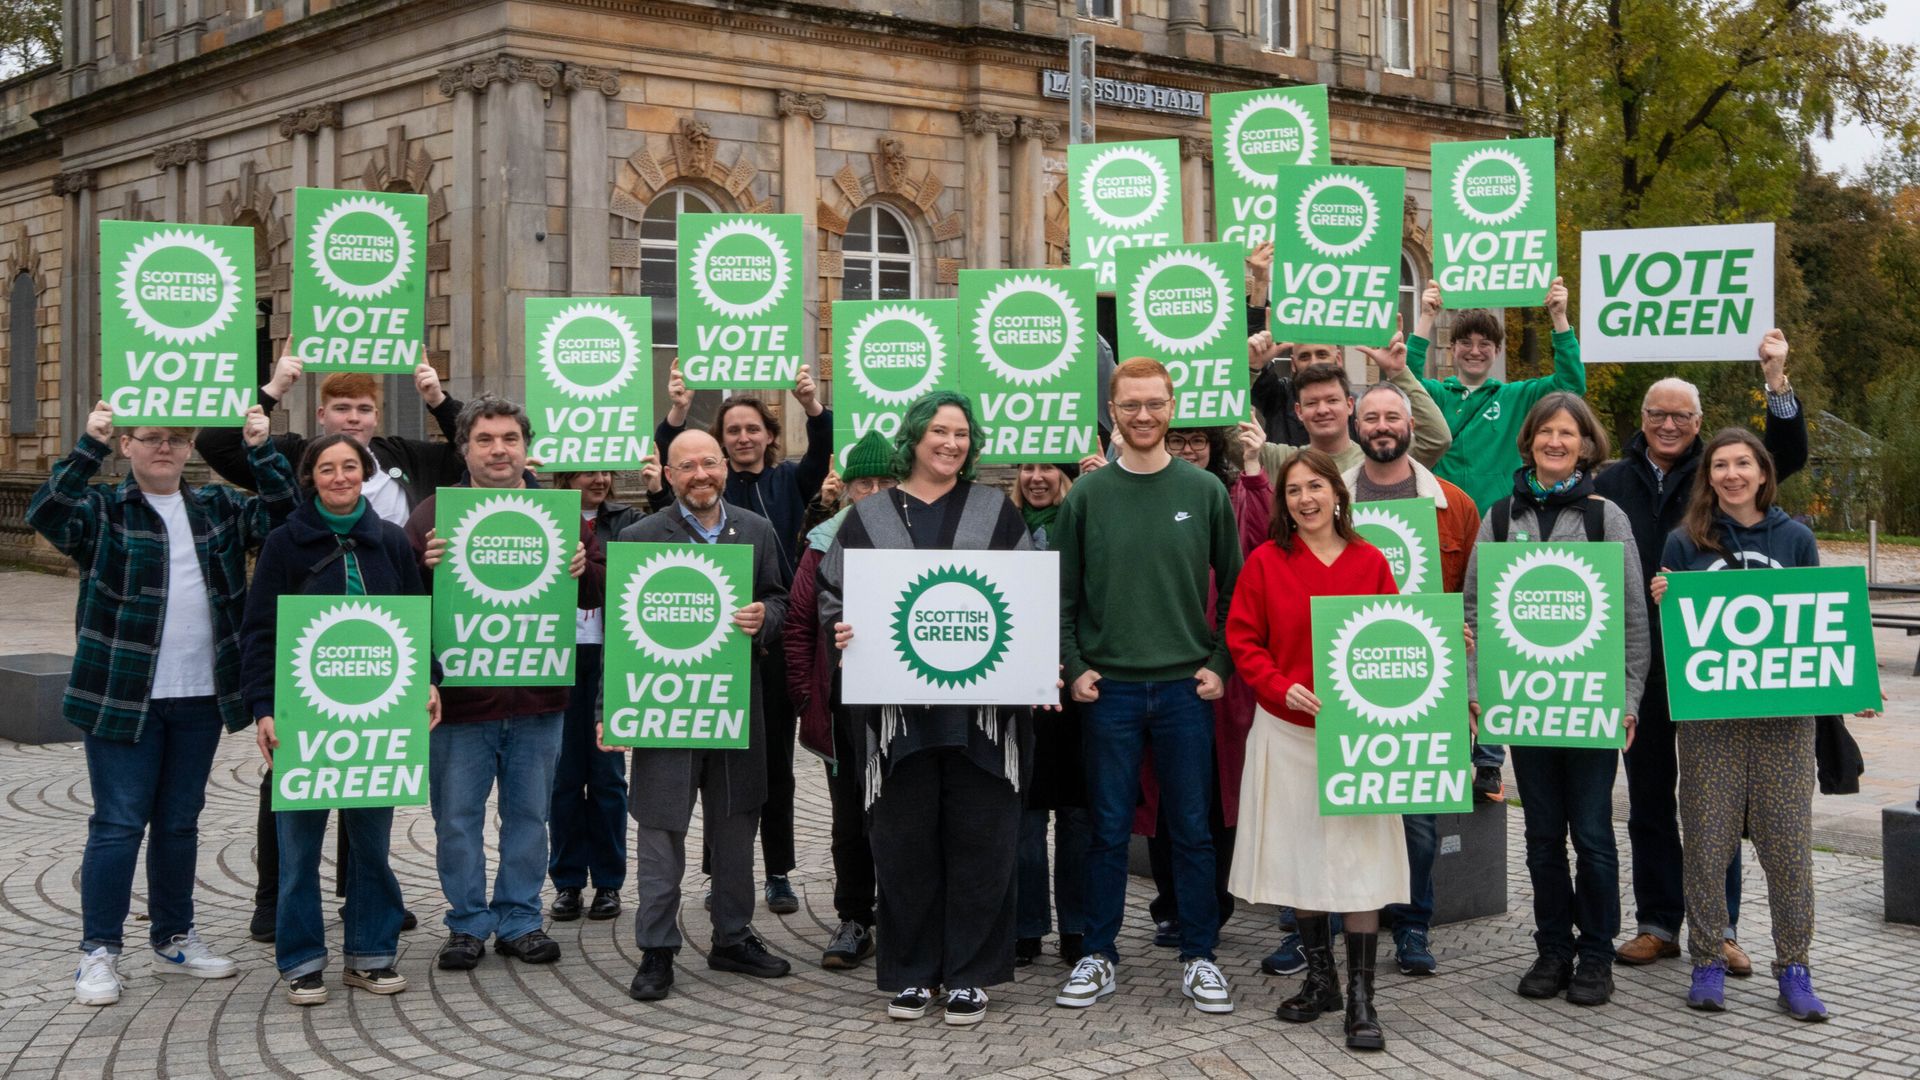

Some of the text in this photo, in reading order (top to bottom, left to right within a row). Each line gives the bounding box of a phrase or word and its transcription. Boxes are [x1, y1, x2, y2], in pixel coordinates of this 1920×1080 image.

[1051, 73, 1201, 112] LAGSIDE HALL
[1241, 127, 1299, 140] SCOTTISH
[1241, 139, 1300, 155] GREENS
[1097, 175, 1152, 187] SCOTTISH
[1466, 175, 1516, 188] SCOTTISH
[1096, 186, 1153, 199] GREENS
[1466, 185, 1517, 197] GREENS
[1232, 195, 1277, 221] VO
[1312, 204, 1363, 214] SCOTTISH
[1311, 214, 1362, 227] GREENS
[331, 233, 394, 248] SCOTTISH
[1443, 229, 1547, 263] VOTE
[329, 246, 393, 262] GREENS
[710, 256, 771, 268] SCOTTISH
[142, 271, 217, 285] SCOTTISH
[709, 268, 772, 282] GREENS
[1283, 262, 1390, 298] VOTE
[1439, 262, 1552, 292] GREEN
[1599, 248, 1755, 298] VOTE
[141, 285, 218, 302] GREENS
[1149, 286, 1213, 302] SCOTTISH
[1149, 300, 1213, 317] GREENS
[1276, 297, 1393, 329] GREEN
[1597, 297, 1754, 337] GREEN
[313, 306, 408, 333] VOTE
[994, 316, 1062, 329] SCOTTISH
[558, 338, 620, 350] SCOTTISH
[697, 325, 788, 352] VOTE
[993, 329, 1062, 344] GREENS
[299, 337, 418, 365] GREEN
[864, 341, 926, 354] SCOTTISH
[558, 350, 620, 364] GREENS
[864, 353, 927, 369] GREENS
[125, 351, 238, 382] VOTE
[684, 356, 800, 382] GREEN
[1167, 358, 1232, 388] OTE
[110, 386, 252, 417] GREEN
[980, 392, 1080, 421] VOTE
[1175, 389, 1246, 420] EEN
[545, 406, 639, 432] VOTE
[852, 412, 904, 439] VO
[532, 437, 649, 464] GREEN
[473, 536, 542, 548] SCOTTISH
[470, 549, 542, 564] GREENS
[643, 592, 715, 605] SCOTTISH
[1514, 591, 1585, 604] SCOTTISH
[642, 606, 715, 622] GREENS
[916, 610, 988, 623] SCOTTISH
[1513, 603, 1586, 620] GREENS
[1679, 592, 1849, 648] VOTE
[455, 613, 560, 643] VOTE
[913, 624, 989, 641] GREENS
[318, 646, 392, 659] SCOTTISH
[1353, 646, 1427, 662] SCOTTISH
[316, 660, 392, 676] GREENS
[438, 647, 570, 677] GREEN
[1352, 661, 1428, 680] GREENS
[1685, 645, 1856, 692] GREEN
[626, 672, 733, 704] VOTE
[1500, 670, 1607, 702] VOTE
[610, 707, 744, 739] GREEN
[1484, 704, 1620, 737] GREEN
[298, 728, 411, 762] VOTE
[1340, 732, 1451, 767] VOTE
[280, 764, 424, 800] GREEN
[1325, 769, 1467, 805] GREEN
